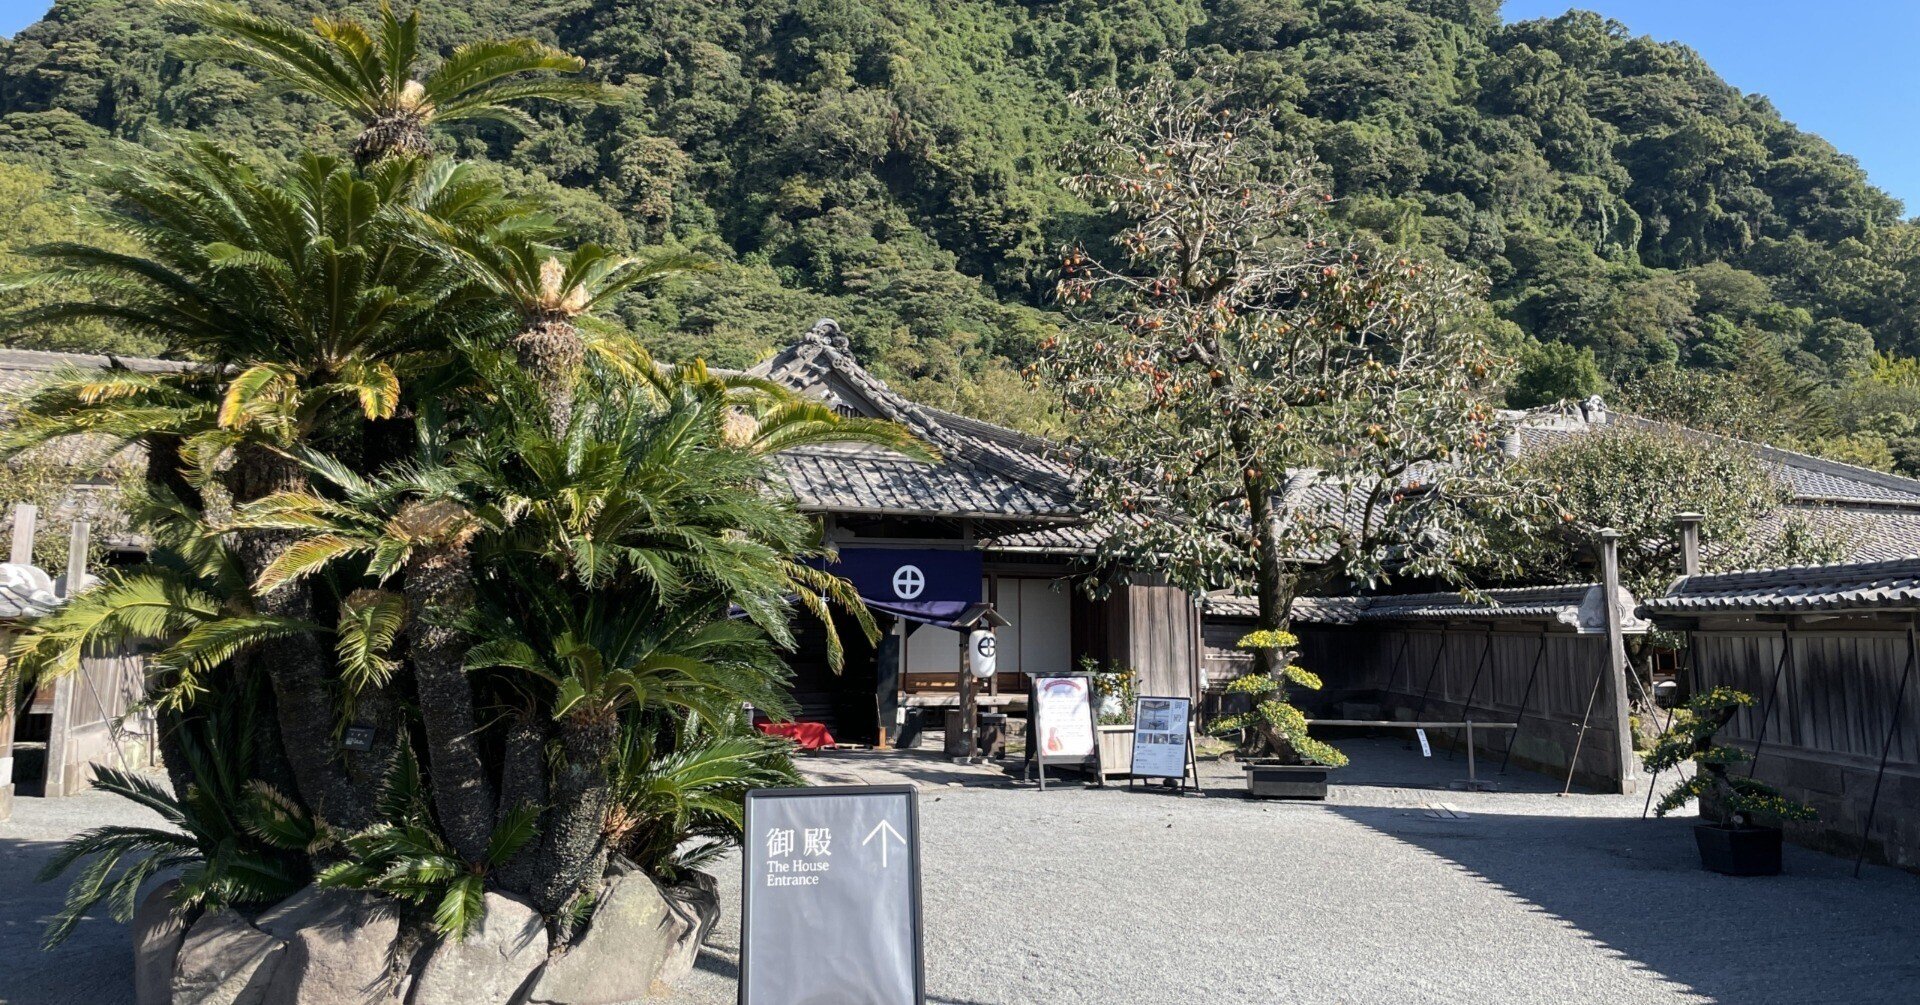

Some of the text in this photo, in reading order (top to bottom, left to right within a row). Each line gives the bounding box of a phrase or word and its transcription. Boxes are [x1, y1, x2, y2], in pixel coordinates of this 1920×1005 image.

[766, 860, 830, 872] The House
[767, 874, 819, 886] Entrance
